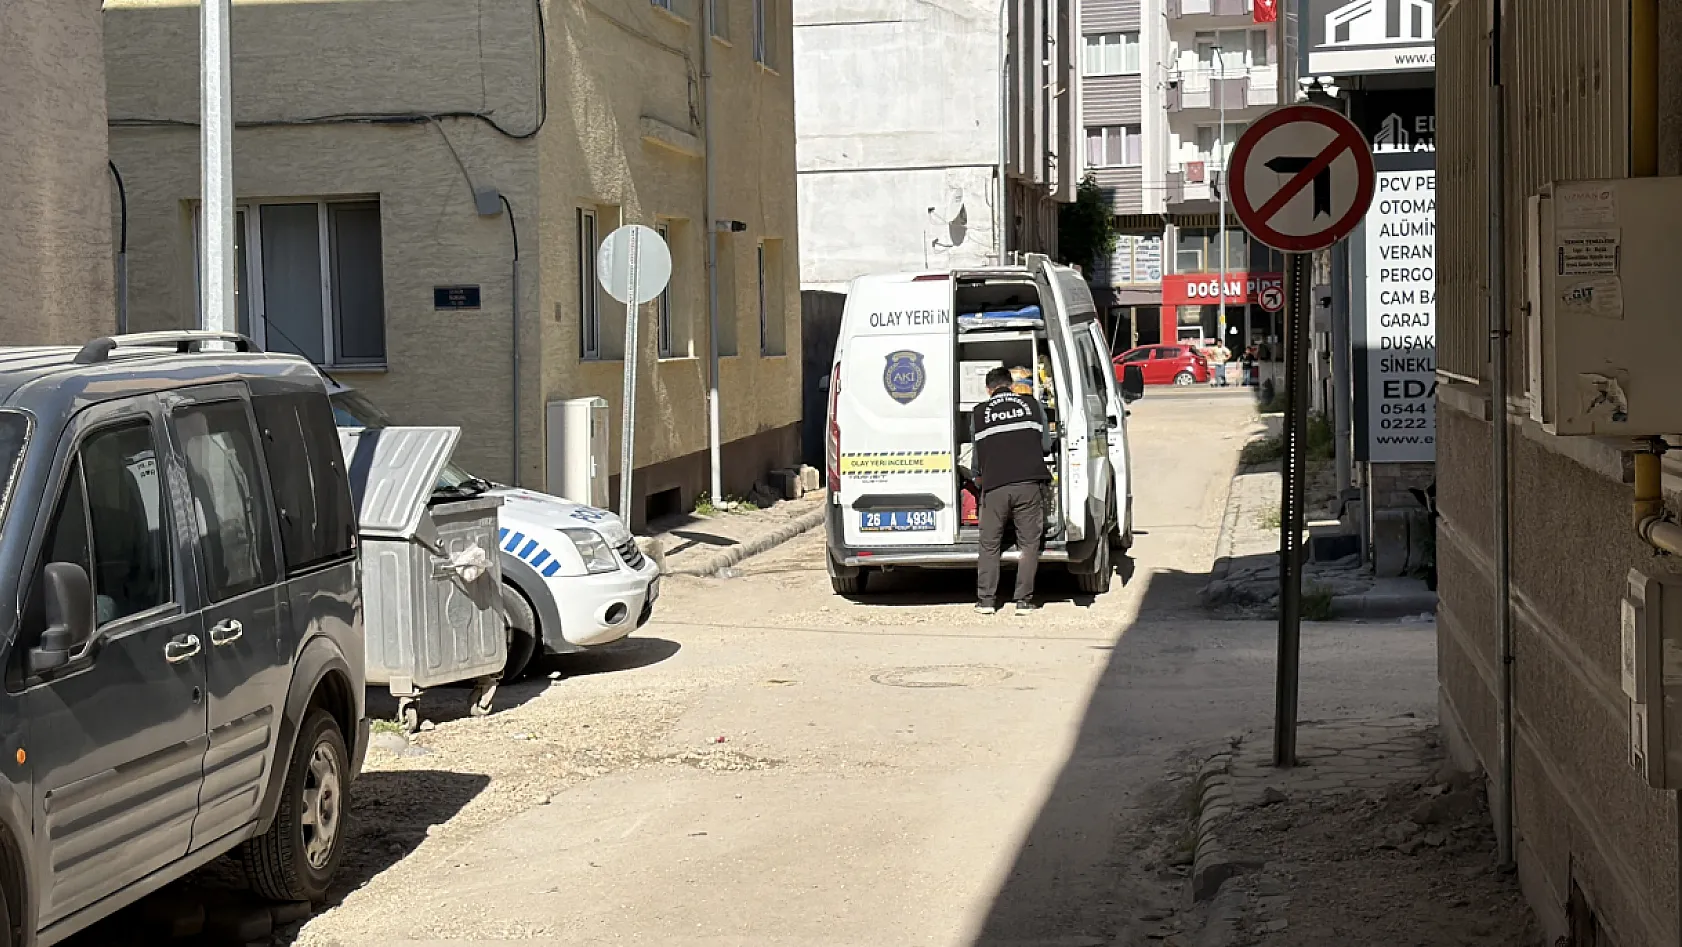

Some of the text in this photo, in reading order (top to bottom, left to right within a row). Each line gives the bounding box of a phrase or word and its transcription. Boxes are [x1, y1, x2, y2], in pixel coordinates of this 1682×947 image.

[1380, 177, 1411, 192] PCV
[1379, 244, 1433, 260] VERAN
[1380, 267, 1433, 282] PERGO
[1187, 279, 1241, 297] DOĞAN
[1380, 290, 1415, 305] CAM
[870, 311, 902, 327] OLAY
[1380, 312, 1429, 327] GARAJ
[1380, 335, 1434, 353] DUŞAK
[1380, 403, 1427, 415] 0544
[1380, 418, 1426, 429] 0222
[867, 513, 880, 526] 26
[890, 511, 897, 526] A
